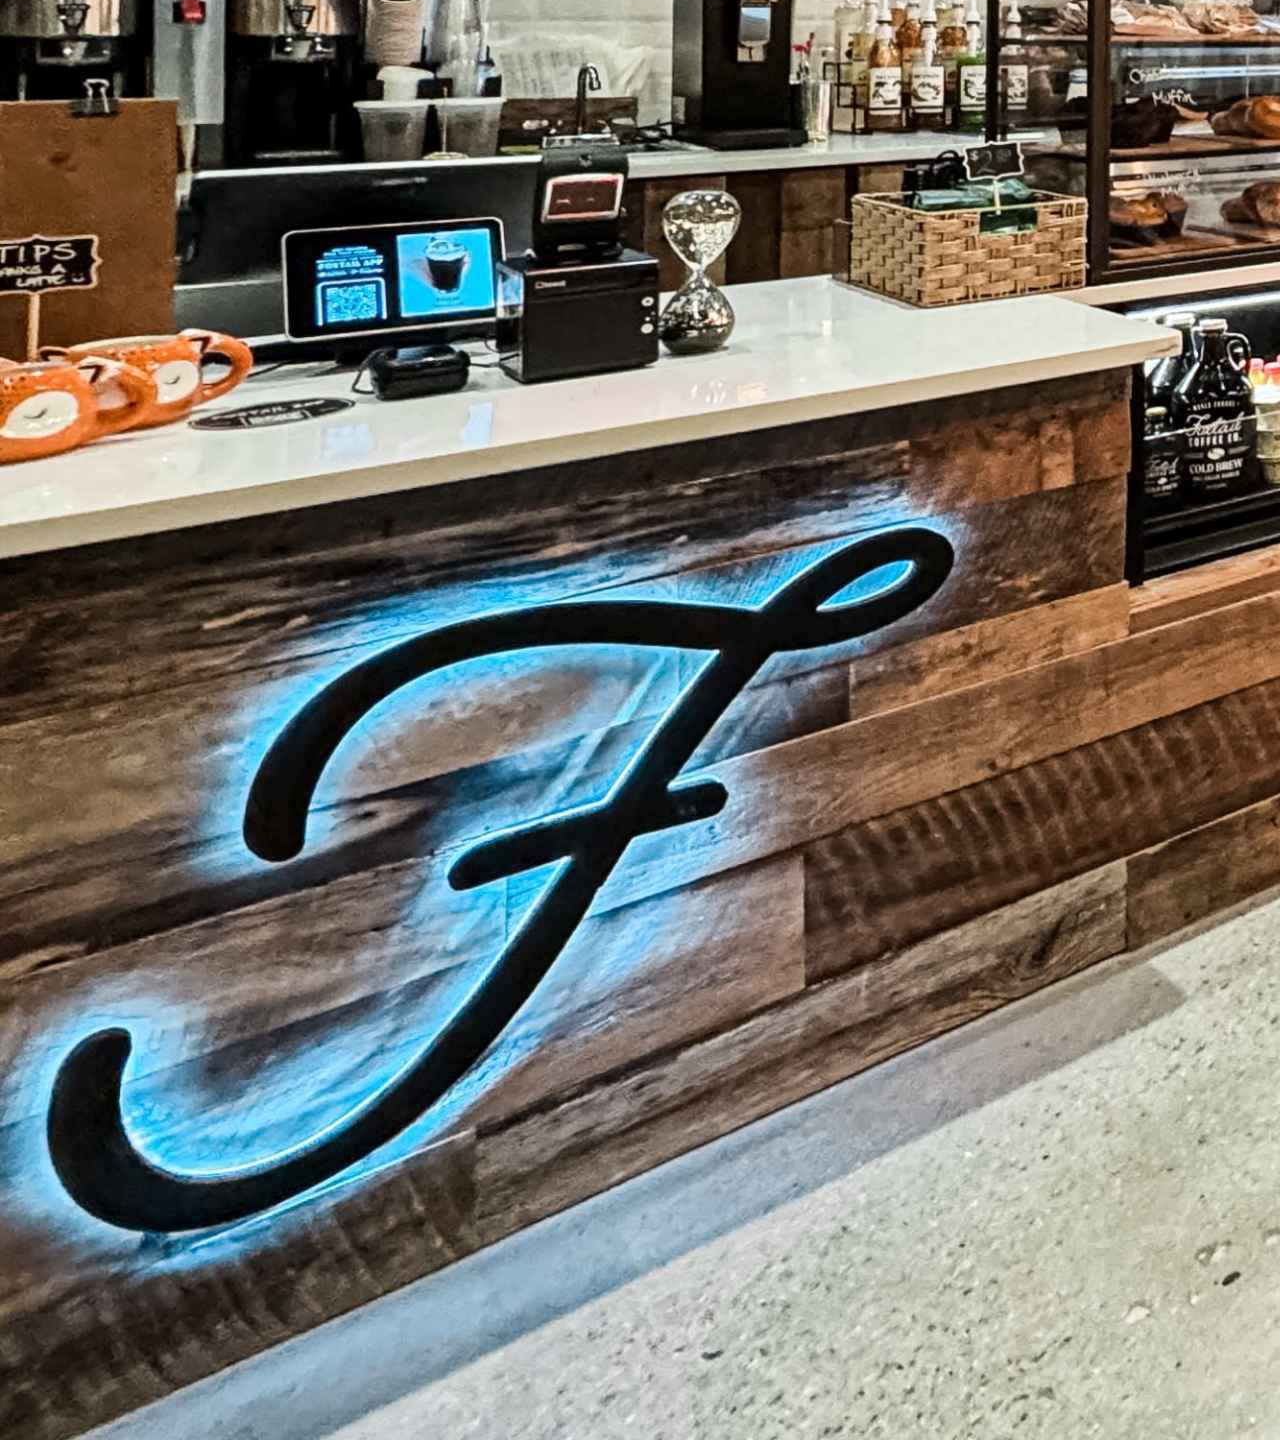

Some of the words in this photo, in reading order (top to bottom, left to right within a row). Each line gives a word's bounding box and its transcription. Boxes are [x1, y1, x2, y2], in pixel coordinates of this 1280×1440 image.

[1151, 88, 1198, 109] Muffin
[0, 242, 77, 264] TIPS
[1188, 434, 1225, 448] COFFEE
[1188, 462, 1215, 475] COLD
[1215, 457, 1244, 472] BREW
[46, 525, 957, 1233] F
